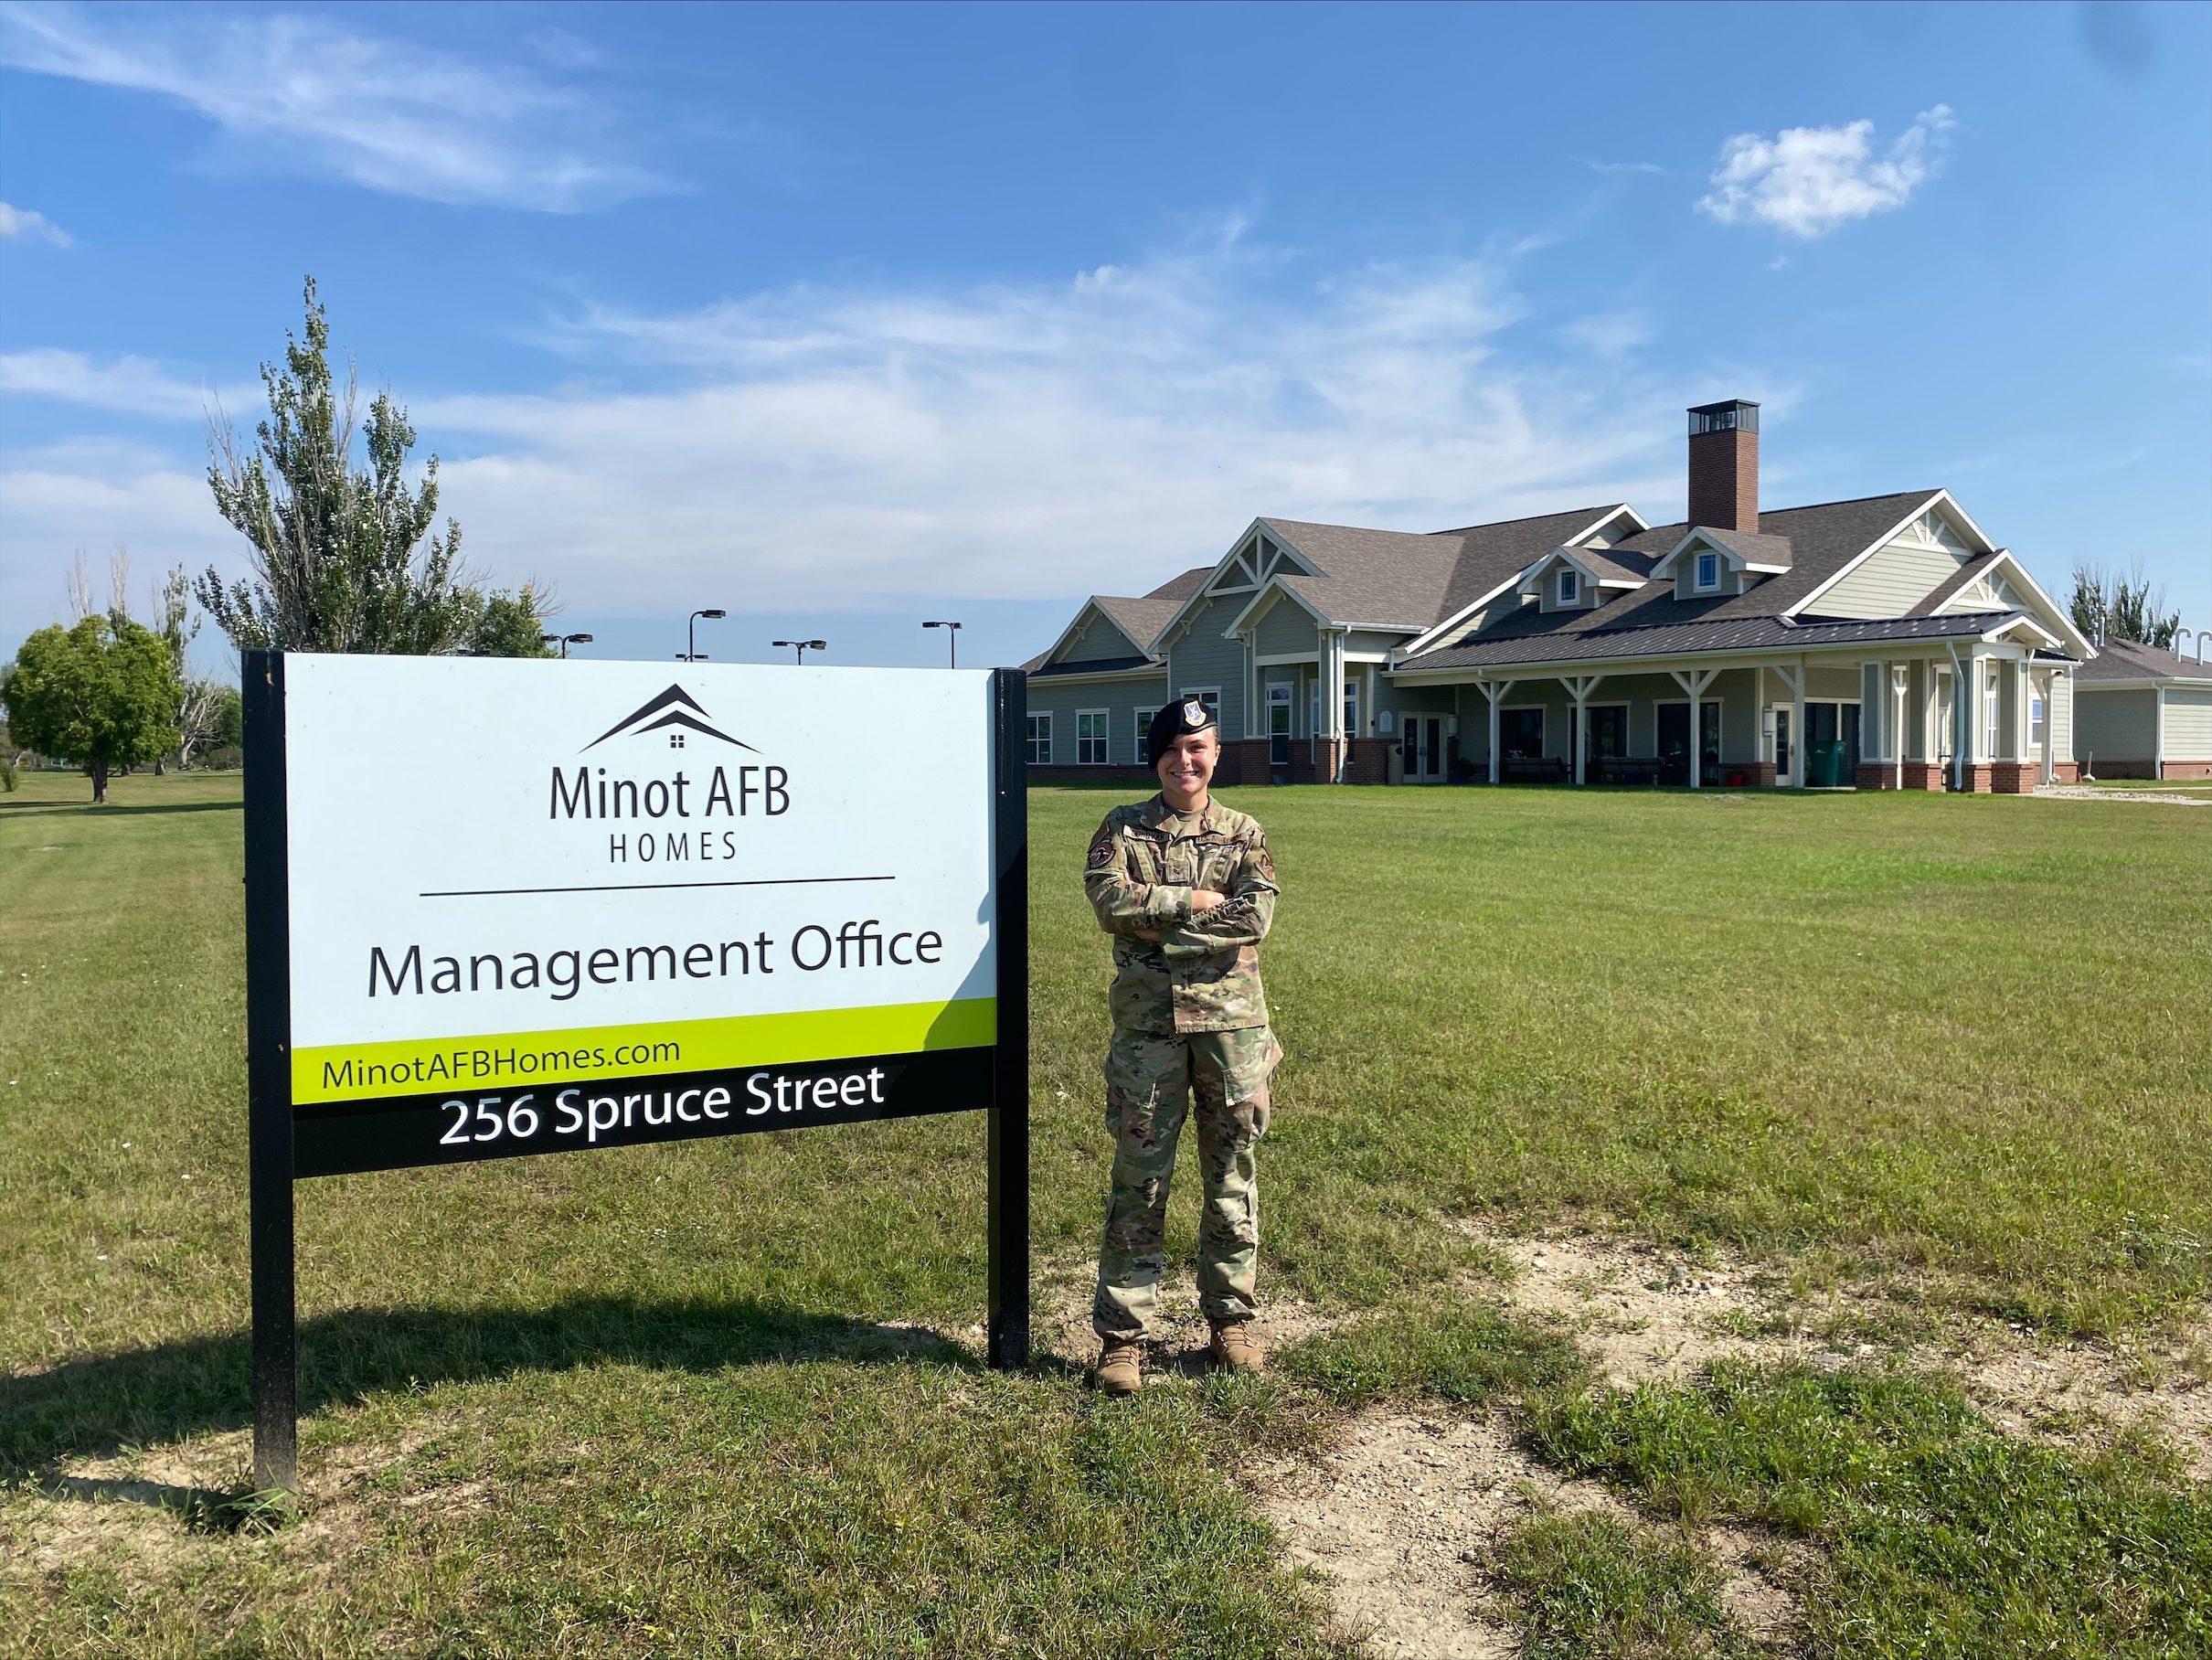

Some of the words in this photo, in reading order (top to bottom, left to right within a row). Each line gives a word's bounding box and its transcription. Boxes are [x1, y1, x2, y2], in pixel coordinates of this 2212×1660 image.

[550, 766, 690, 820] Minot
[705, 765, 790, 817] AFB
[610, 831, 736, 864] HOMES
[368, 931, 774, 1001] Management
[791, 919, 942, 972] Office
[322, 1041, 680, 1090] MinotAFBHomes.com
[439, 1093, 539, 1145] 256
[554, 1086, 731, 1143] Spruce
[744, 1066, 886, 1116] Street
